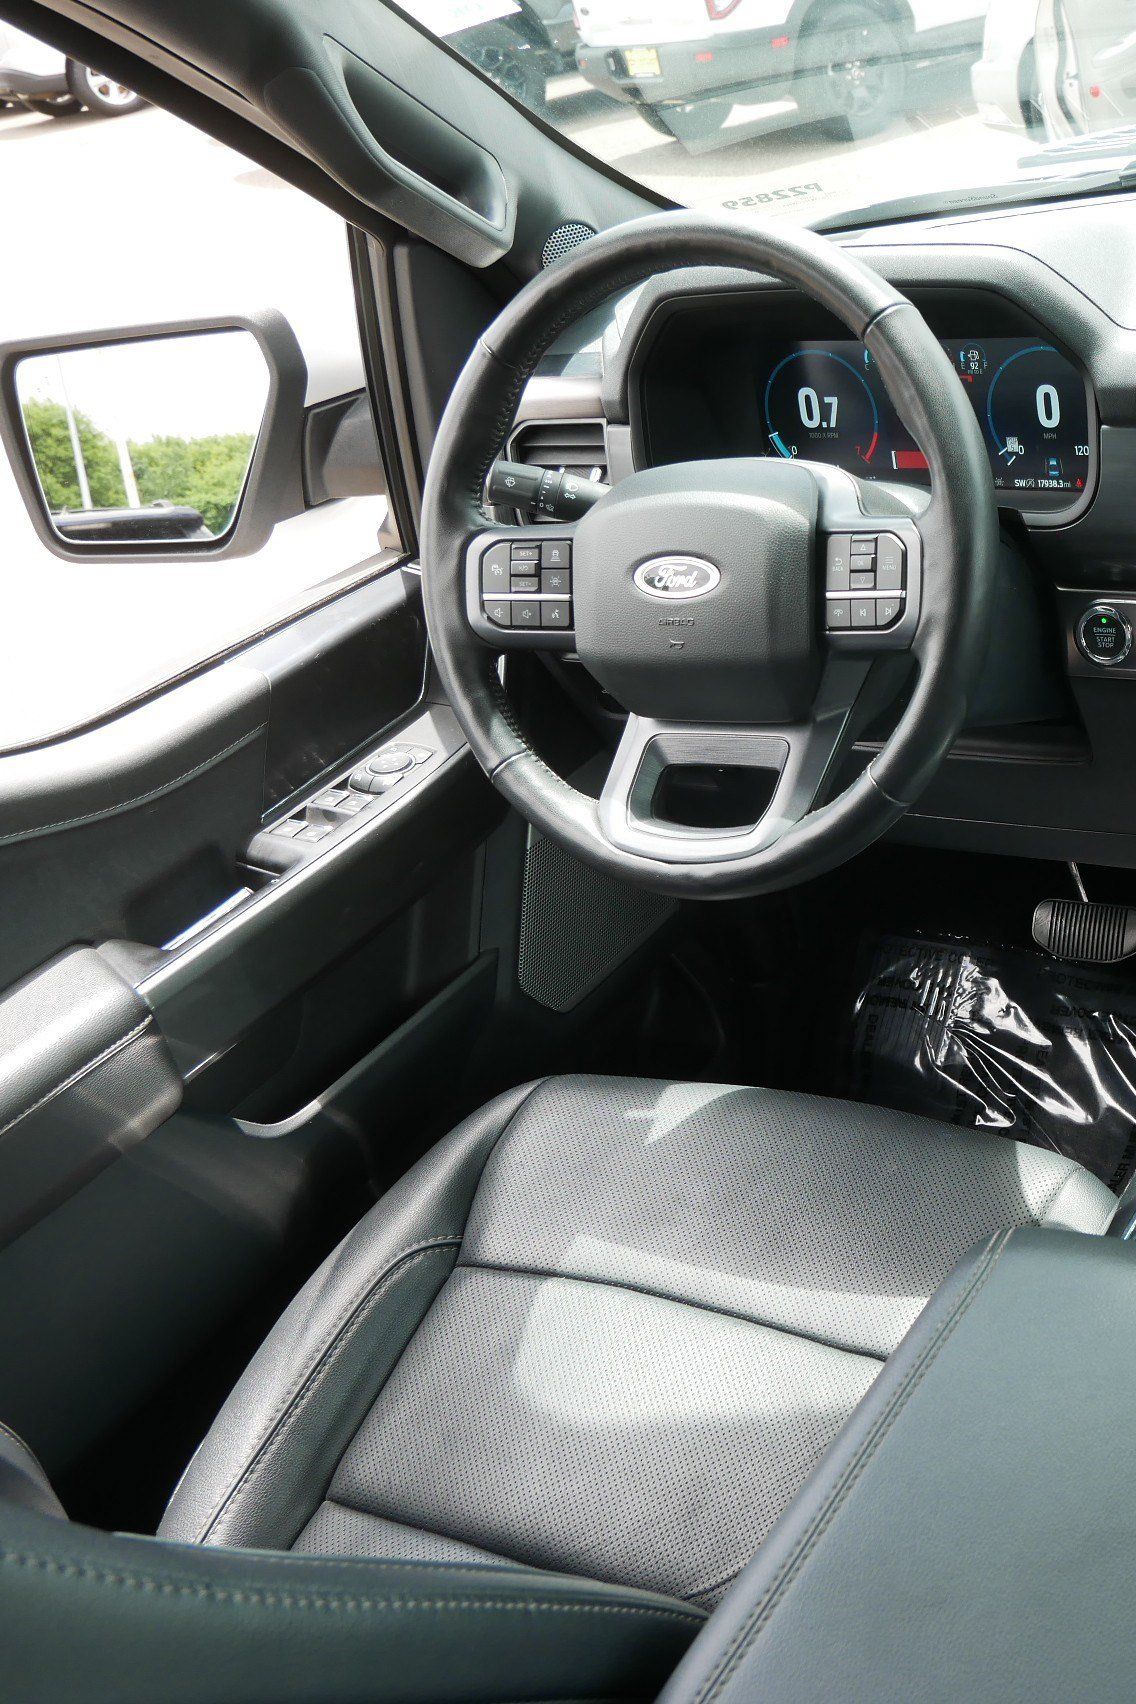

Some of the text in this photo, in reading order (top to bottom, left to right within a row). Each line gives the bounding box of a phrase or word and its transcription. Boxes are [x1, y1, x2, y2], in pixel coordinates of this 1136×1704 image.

[970, 362, 979, 370] 92
[798, 387, 838, 429] 0.7
[1036, 384, 1060, 428] 0
[1043, 432, 1057, 440] MPH
[1018, 446, 1025, 455] 0
[1074, 445, 1090, 456] 120
[1014, 480, 1026, 488] SW
[654, 564, 699, 588] Ford
